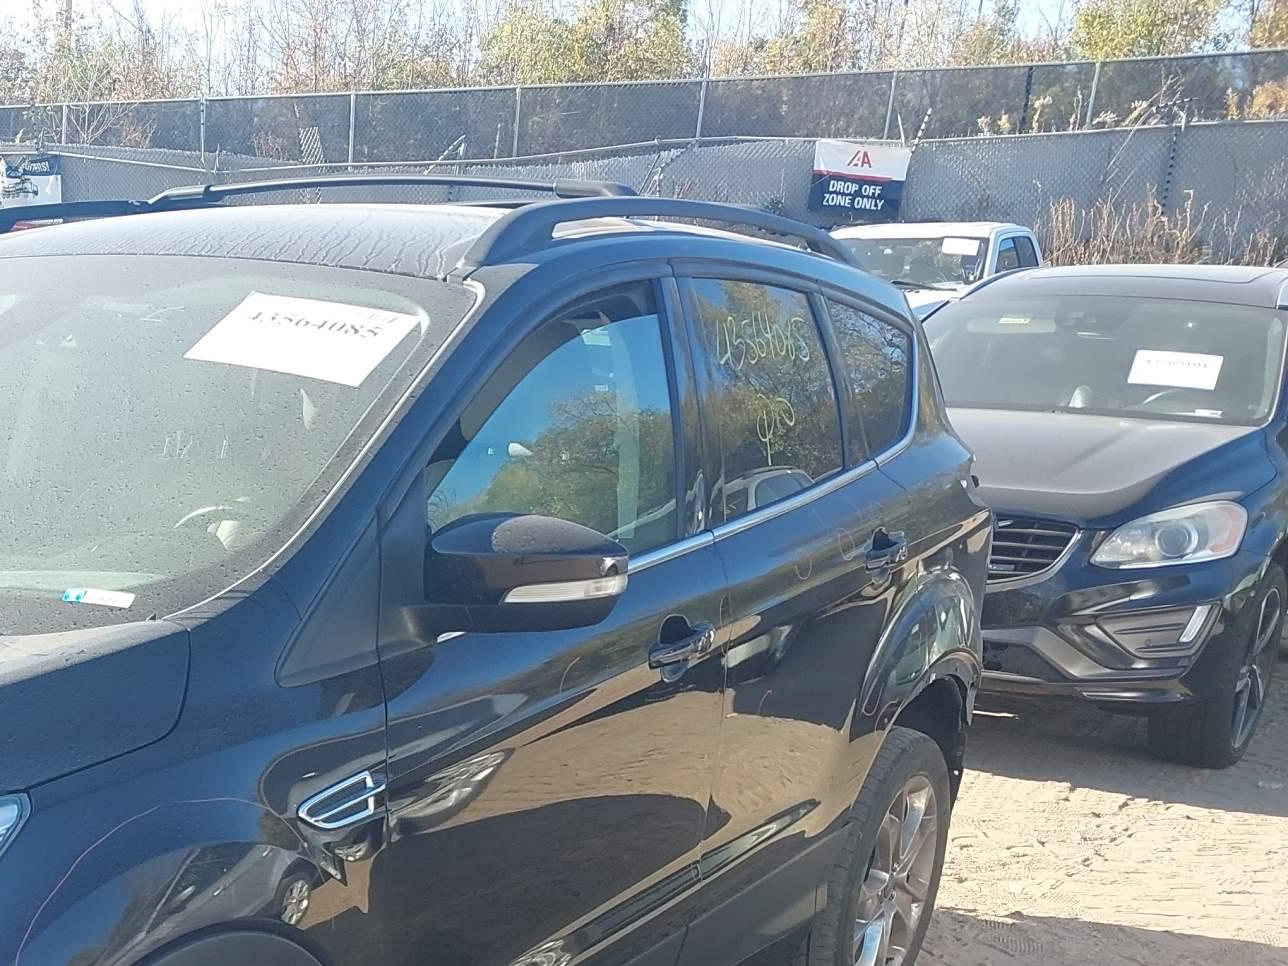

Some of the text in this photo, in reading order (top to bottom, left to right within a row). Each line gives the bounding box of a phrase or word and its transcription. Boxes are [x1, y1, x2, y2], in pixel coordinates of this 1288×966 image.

[829, 181, 883, 197] DROP OFF
[822, 193, 885, 210] ZONE ONLY
[716, 312, 810, 371] 43564085
